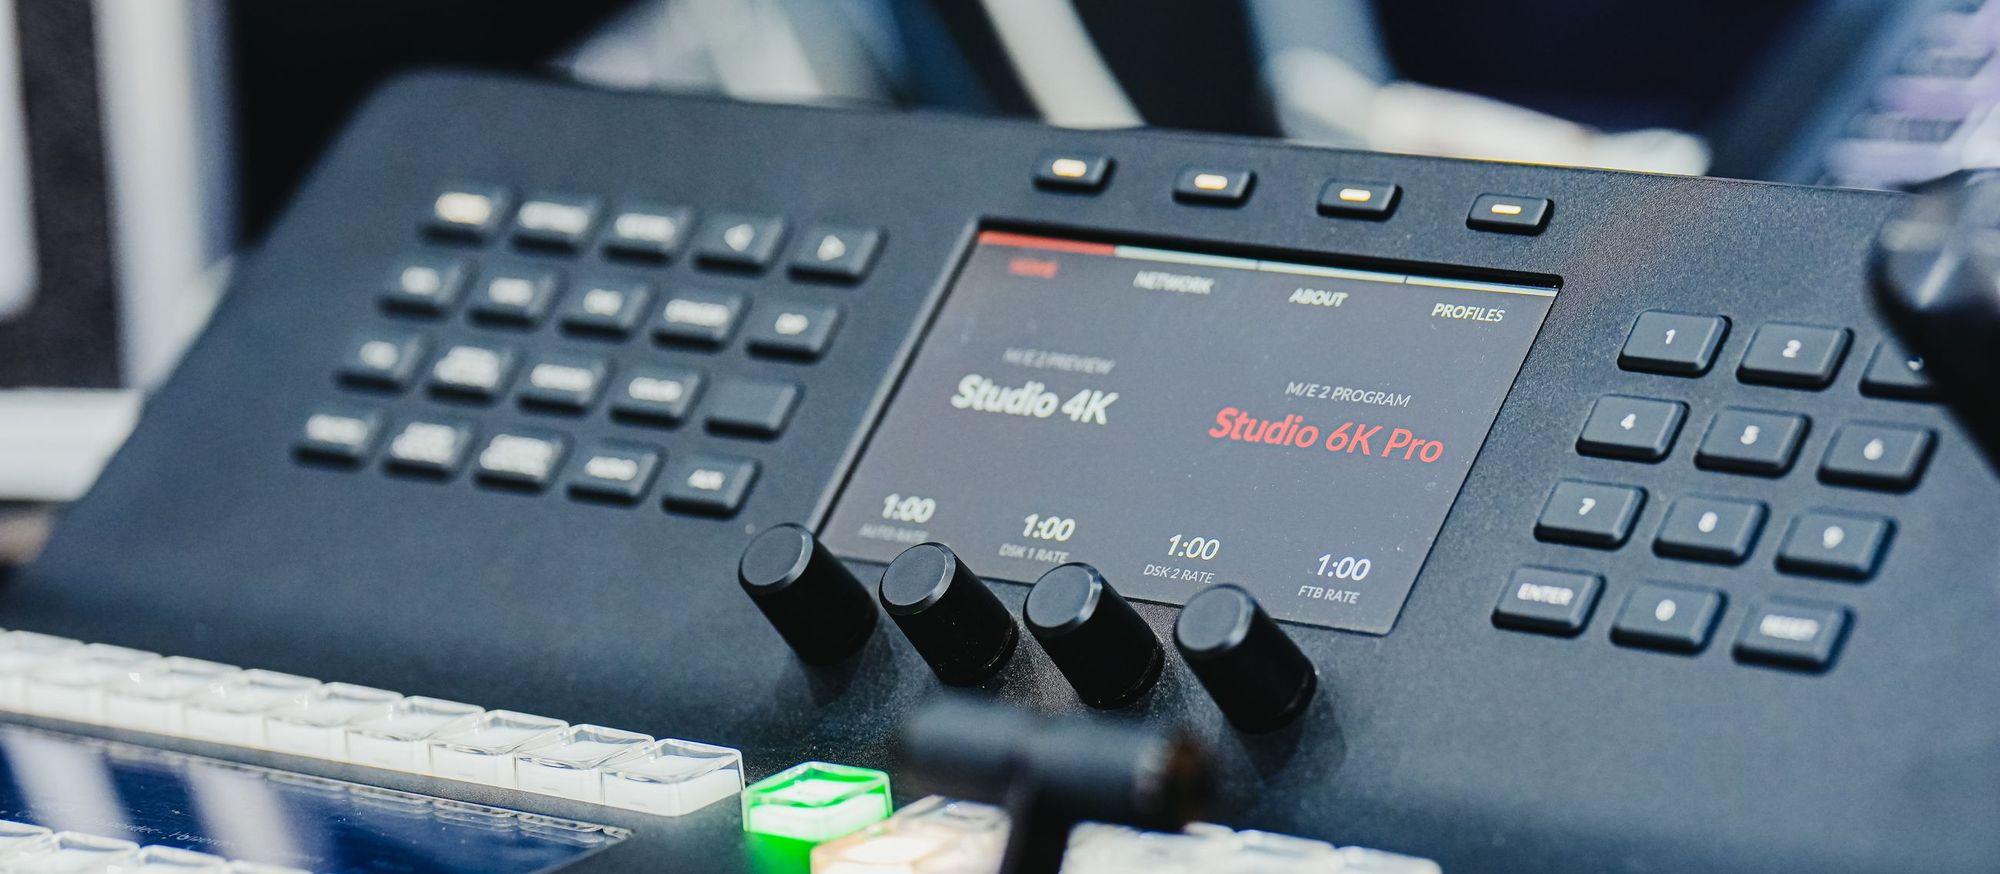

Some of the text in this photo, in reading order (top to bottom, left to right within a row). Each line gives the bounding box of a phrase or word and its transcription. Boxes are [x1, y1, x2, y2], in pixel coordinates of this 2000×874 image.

[1133, 270, 1215, 295] NETWORK
[1288, 287, 1348, 308] ABOUT
[1431, 302, 1505, 323] PROFILES
[1665, 329, 1676, 345] 1
[1782, 339, 1802, 358] 2
[951, 374, 1119, 425] Studio 4K
[1285, 381, 1411, 408] M/E 2 PROGRAM
[1620, 413, 1636, 430] 4
[1208, 406, 1444, 463] Studio 6K Pro
[1740, 425, 1759, 445] 5
[881, 493, 937, 523] 1:00
[1578, 497, 1596, 516] 7
[1022, 513, 1076, 542] 1:00
[999, 543, 1026, 558] DSK
[1035, 547, 1070, 564] RATE
[1167, 534, 1220, 561] 1:00
[1143, 564, 1215, 584] DSK 2 RATE
[1316, 554, 1371, 581] 1:00
[1298, 585, 1360, 605] FTB RATE
